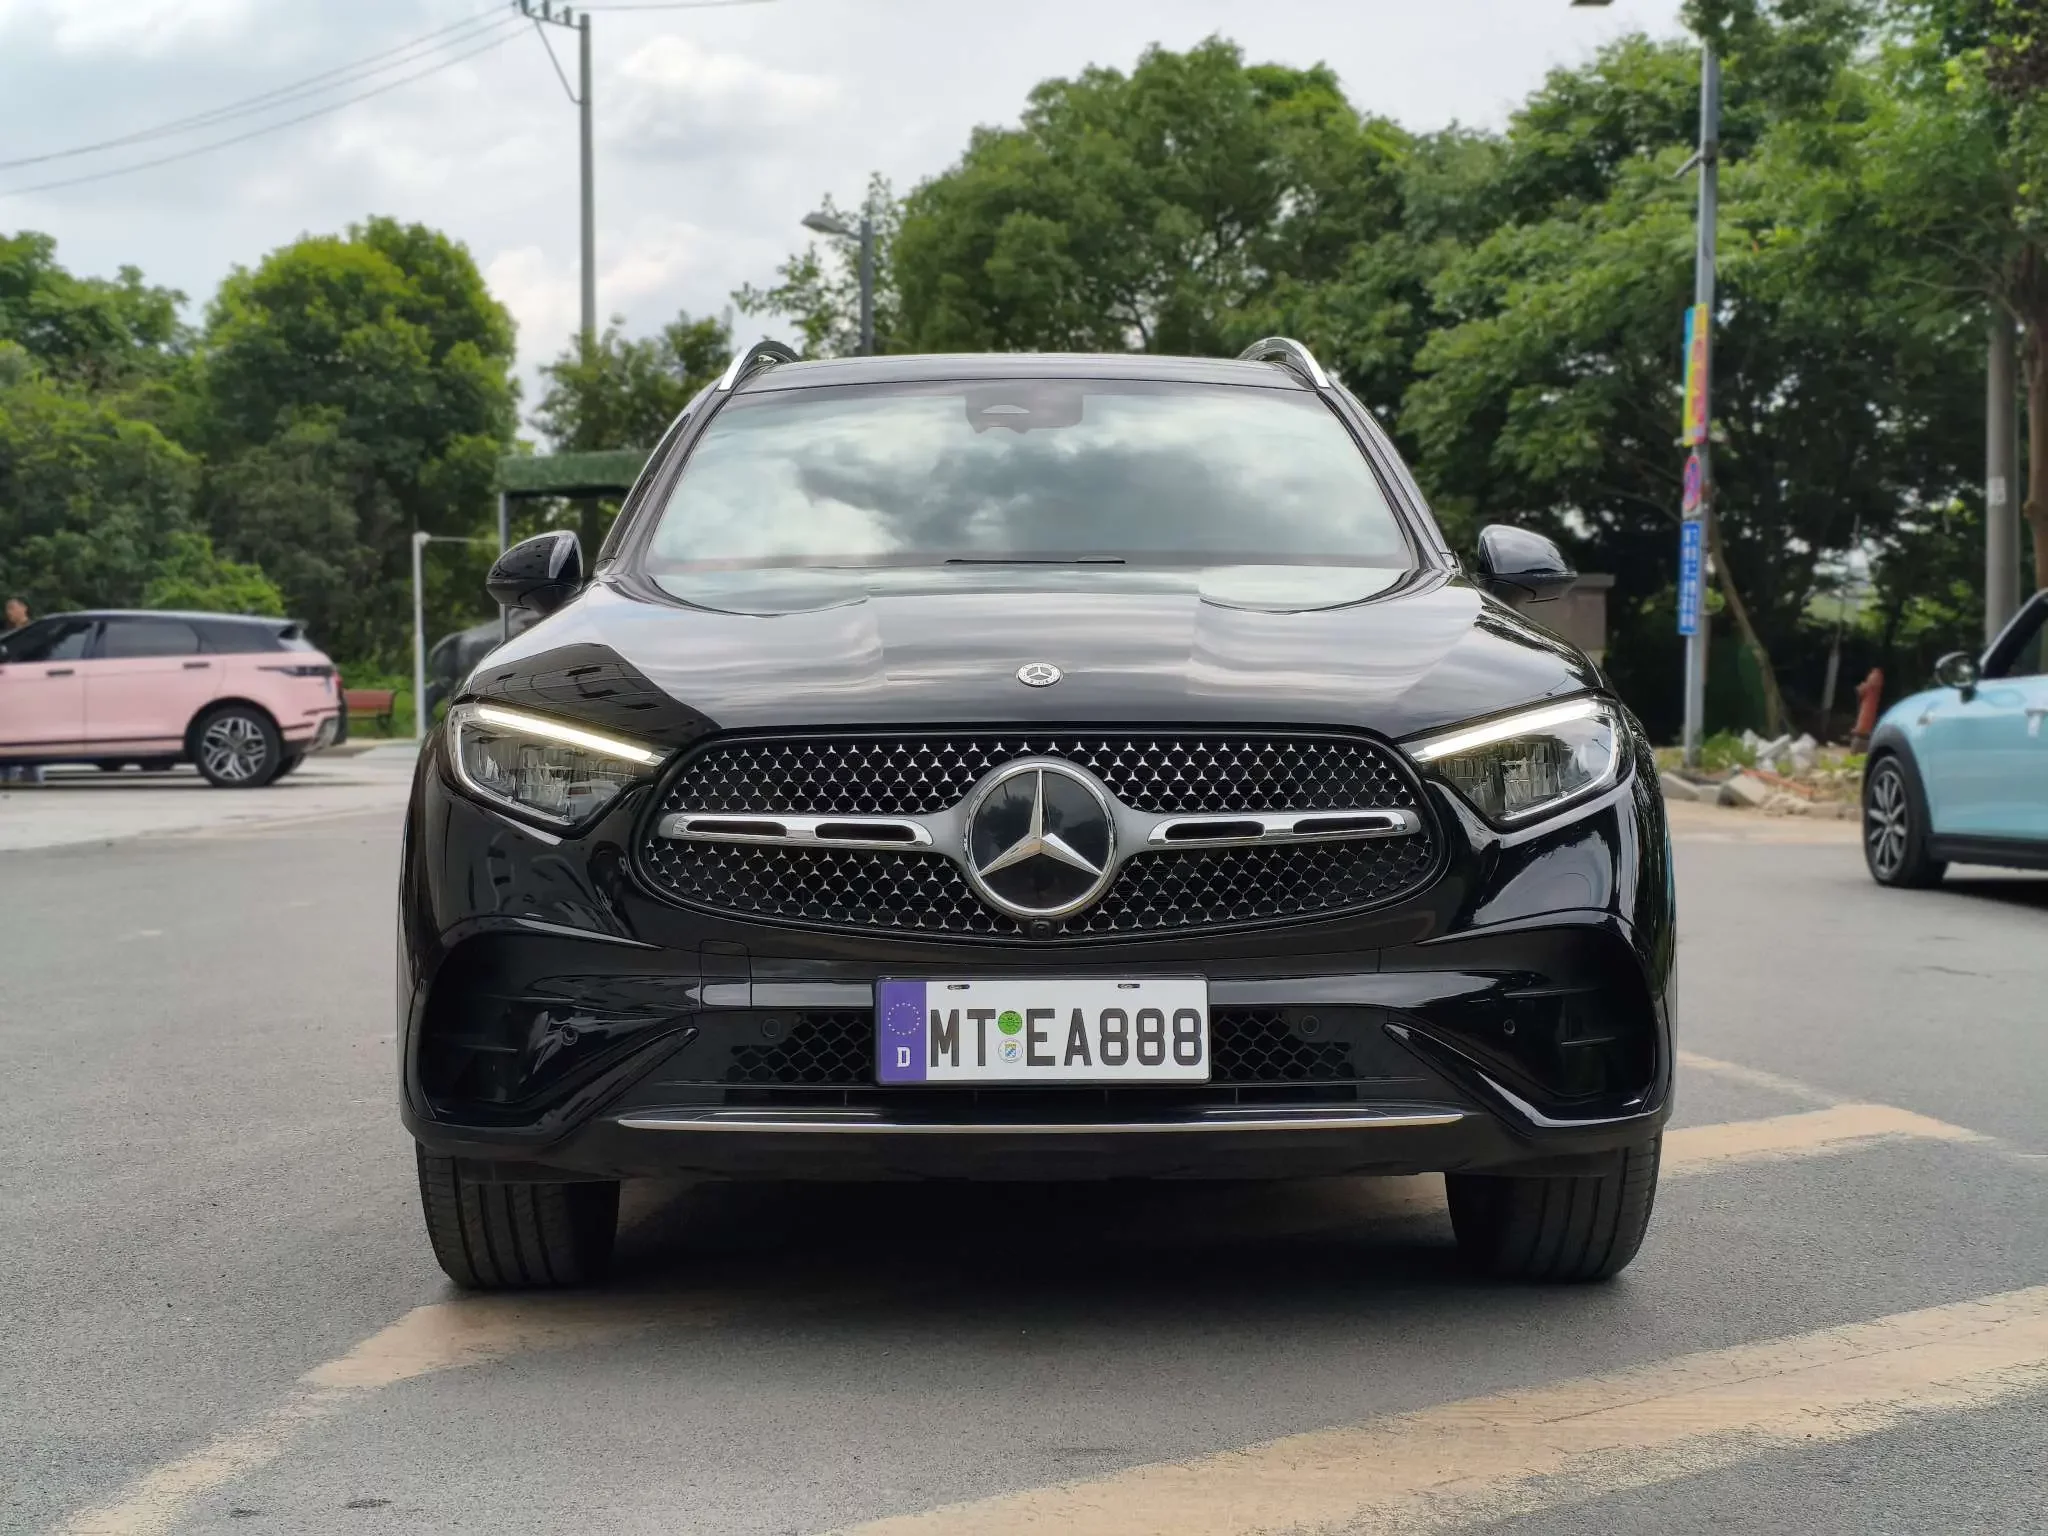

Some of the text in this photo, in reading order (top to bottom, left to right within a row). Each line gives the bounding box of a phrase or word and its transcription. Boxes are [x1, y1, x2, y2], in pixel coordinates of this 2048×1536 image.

[897, 1046, 911, 1068] D
[930, 1008, 1203, 1067] MT EA888
